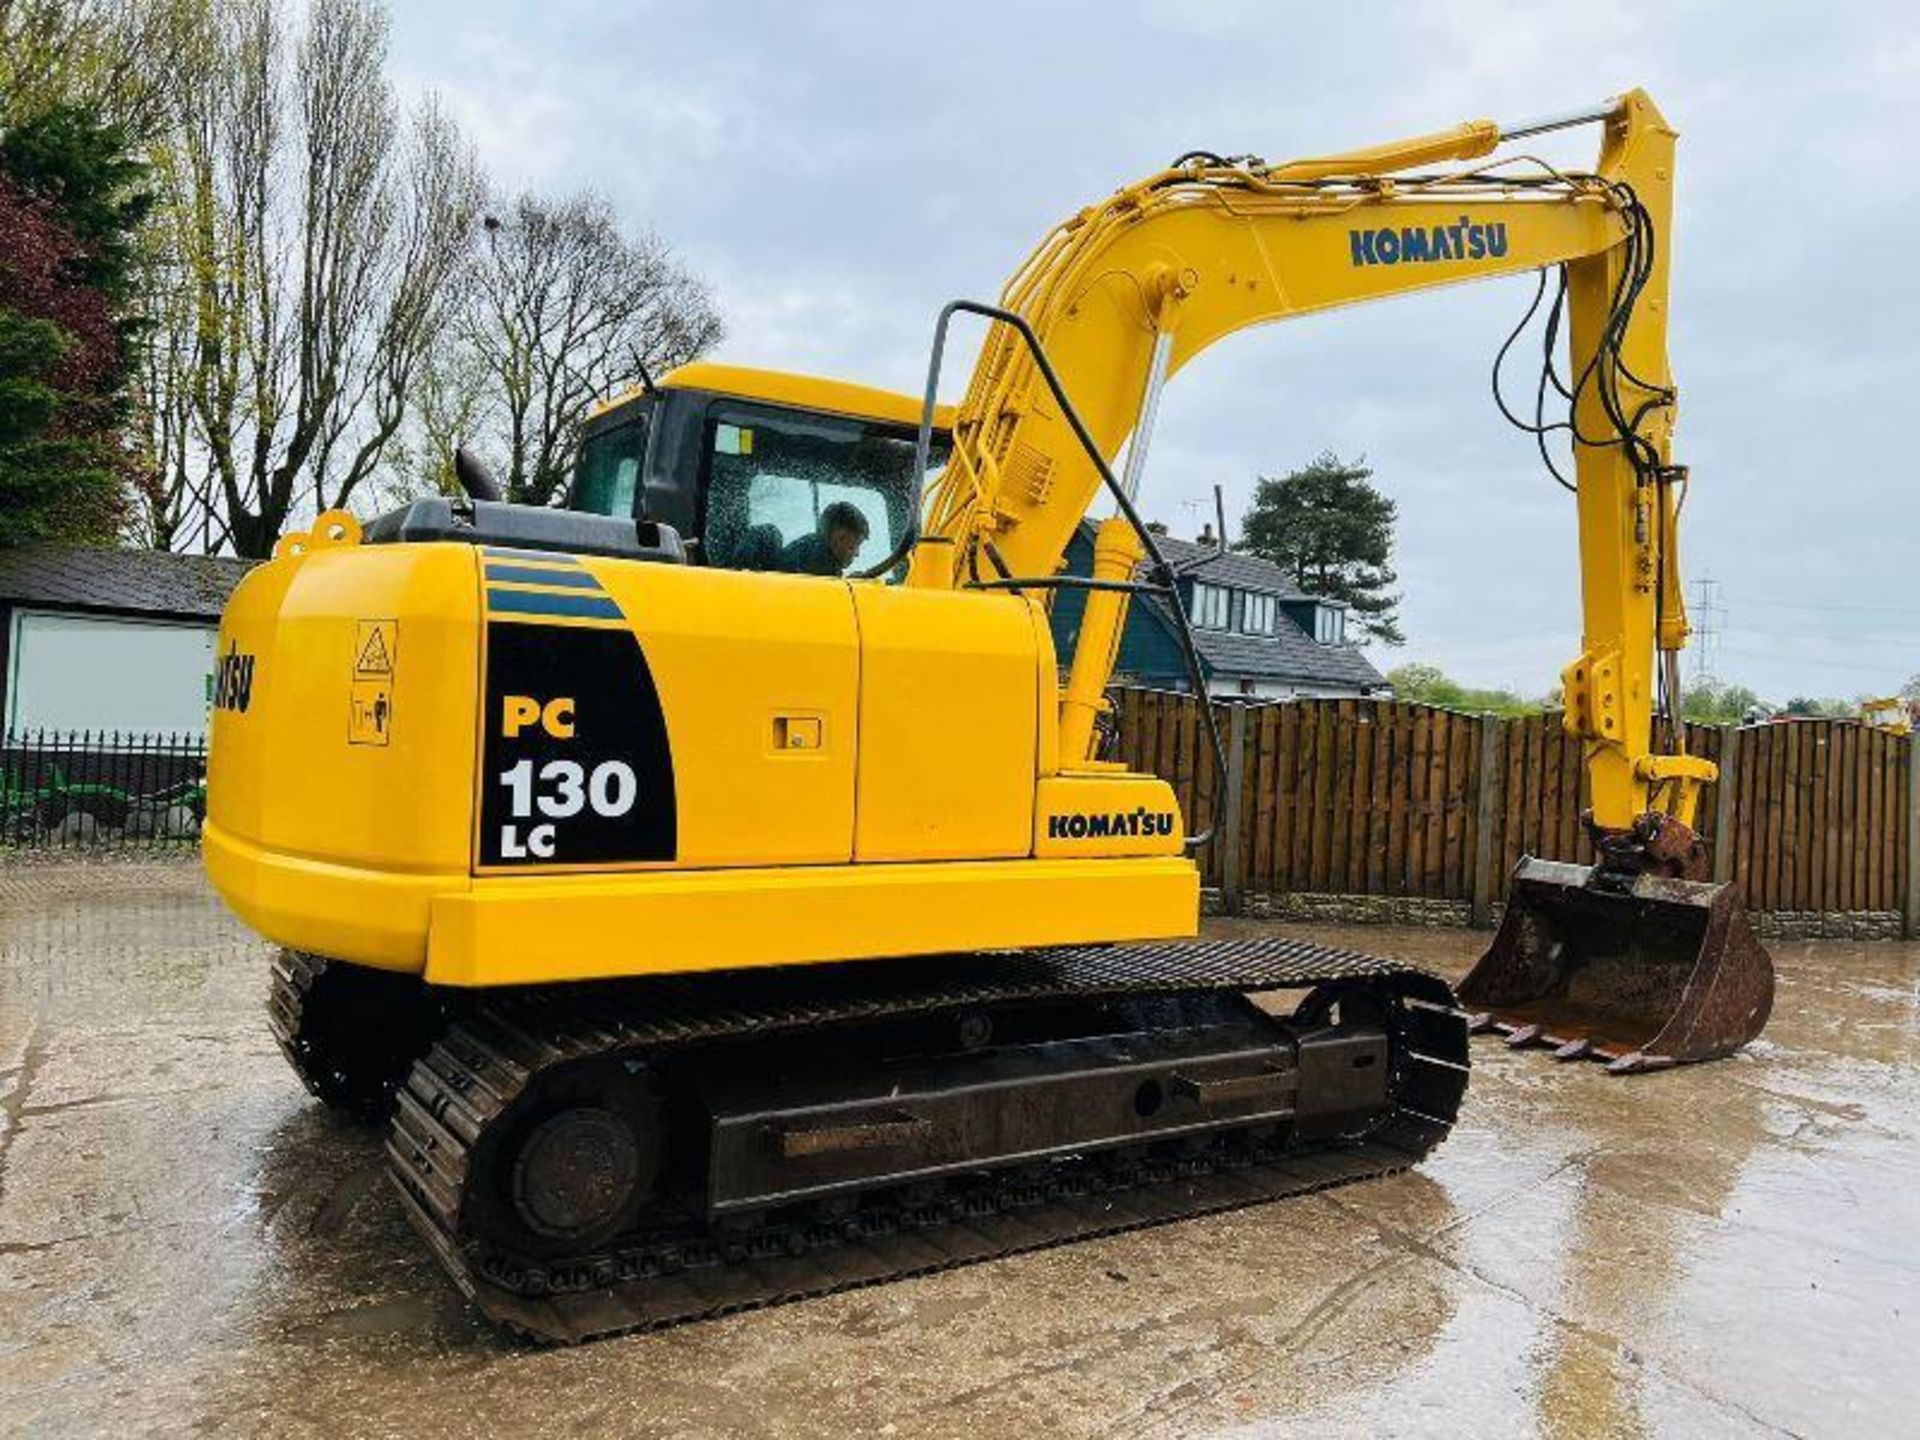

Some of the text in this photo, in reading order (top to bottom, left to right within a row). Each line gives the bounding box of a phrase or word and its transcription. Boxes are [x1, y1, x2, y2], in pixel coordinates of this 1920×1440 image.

[1349, 216, 1507, 266] KOMATSU
[503, 695, 575, 738] PC
[500, 760, 637, 818] 130
[501, 824, 556, 858] LC
[1049, 806, 1173, 838] KOMATSU
